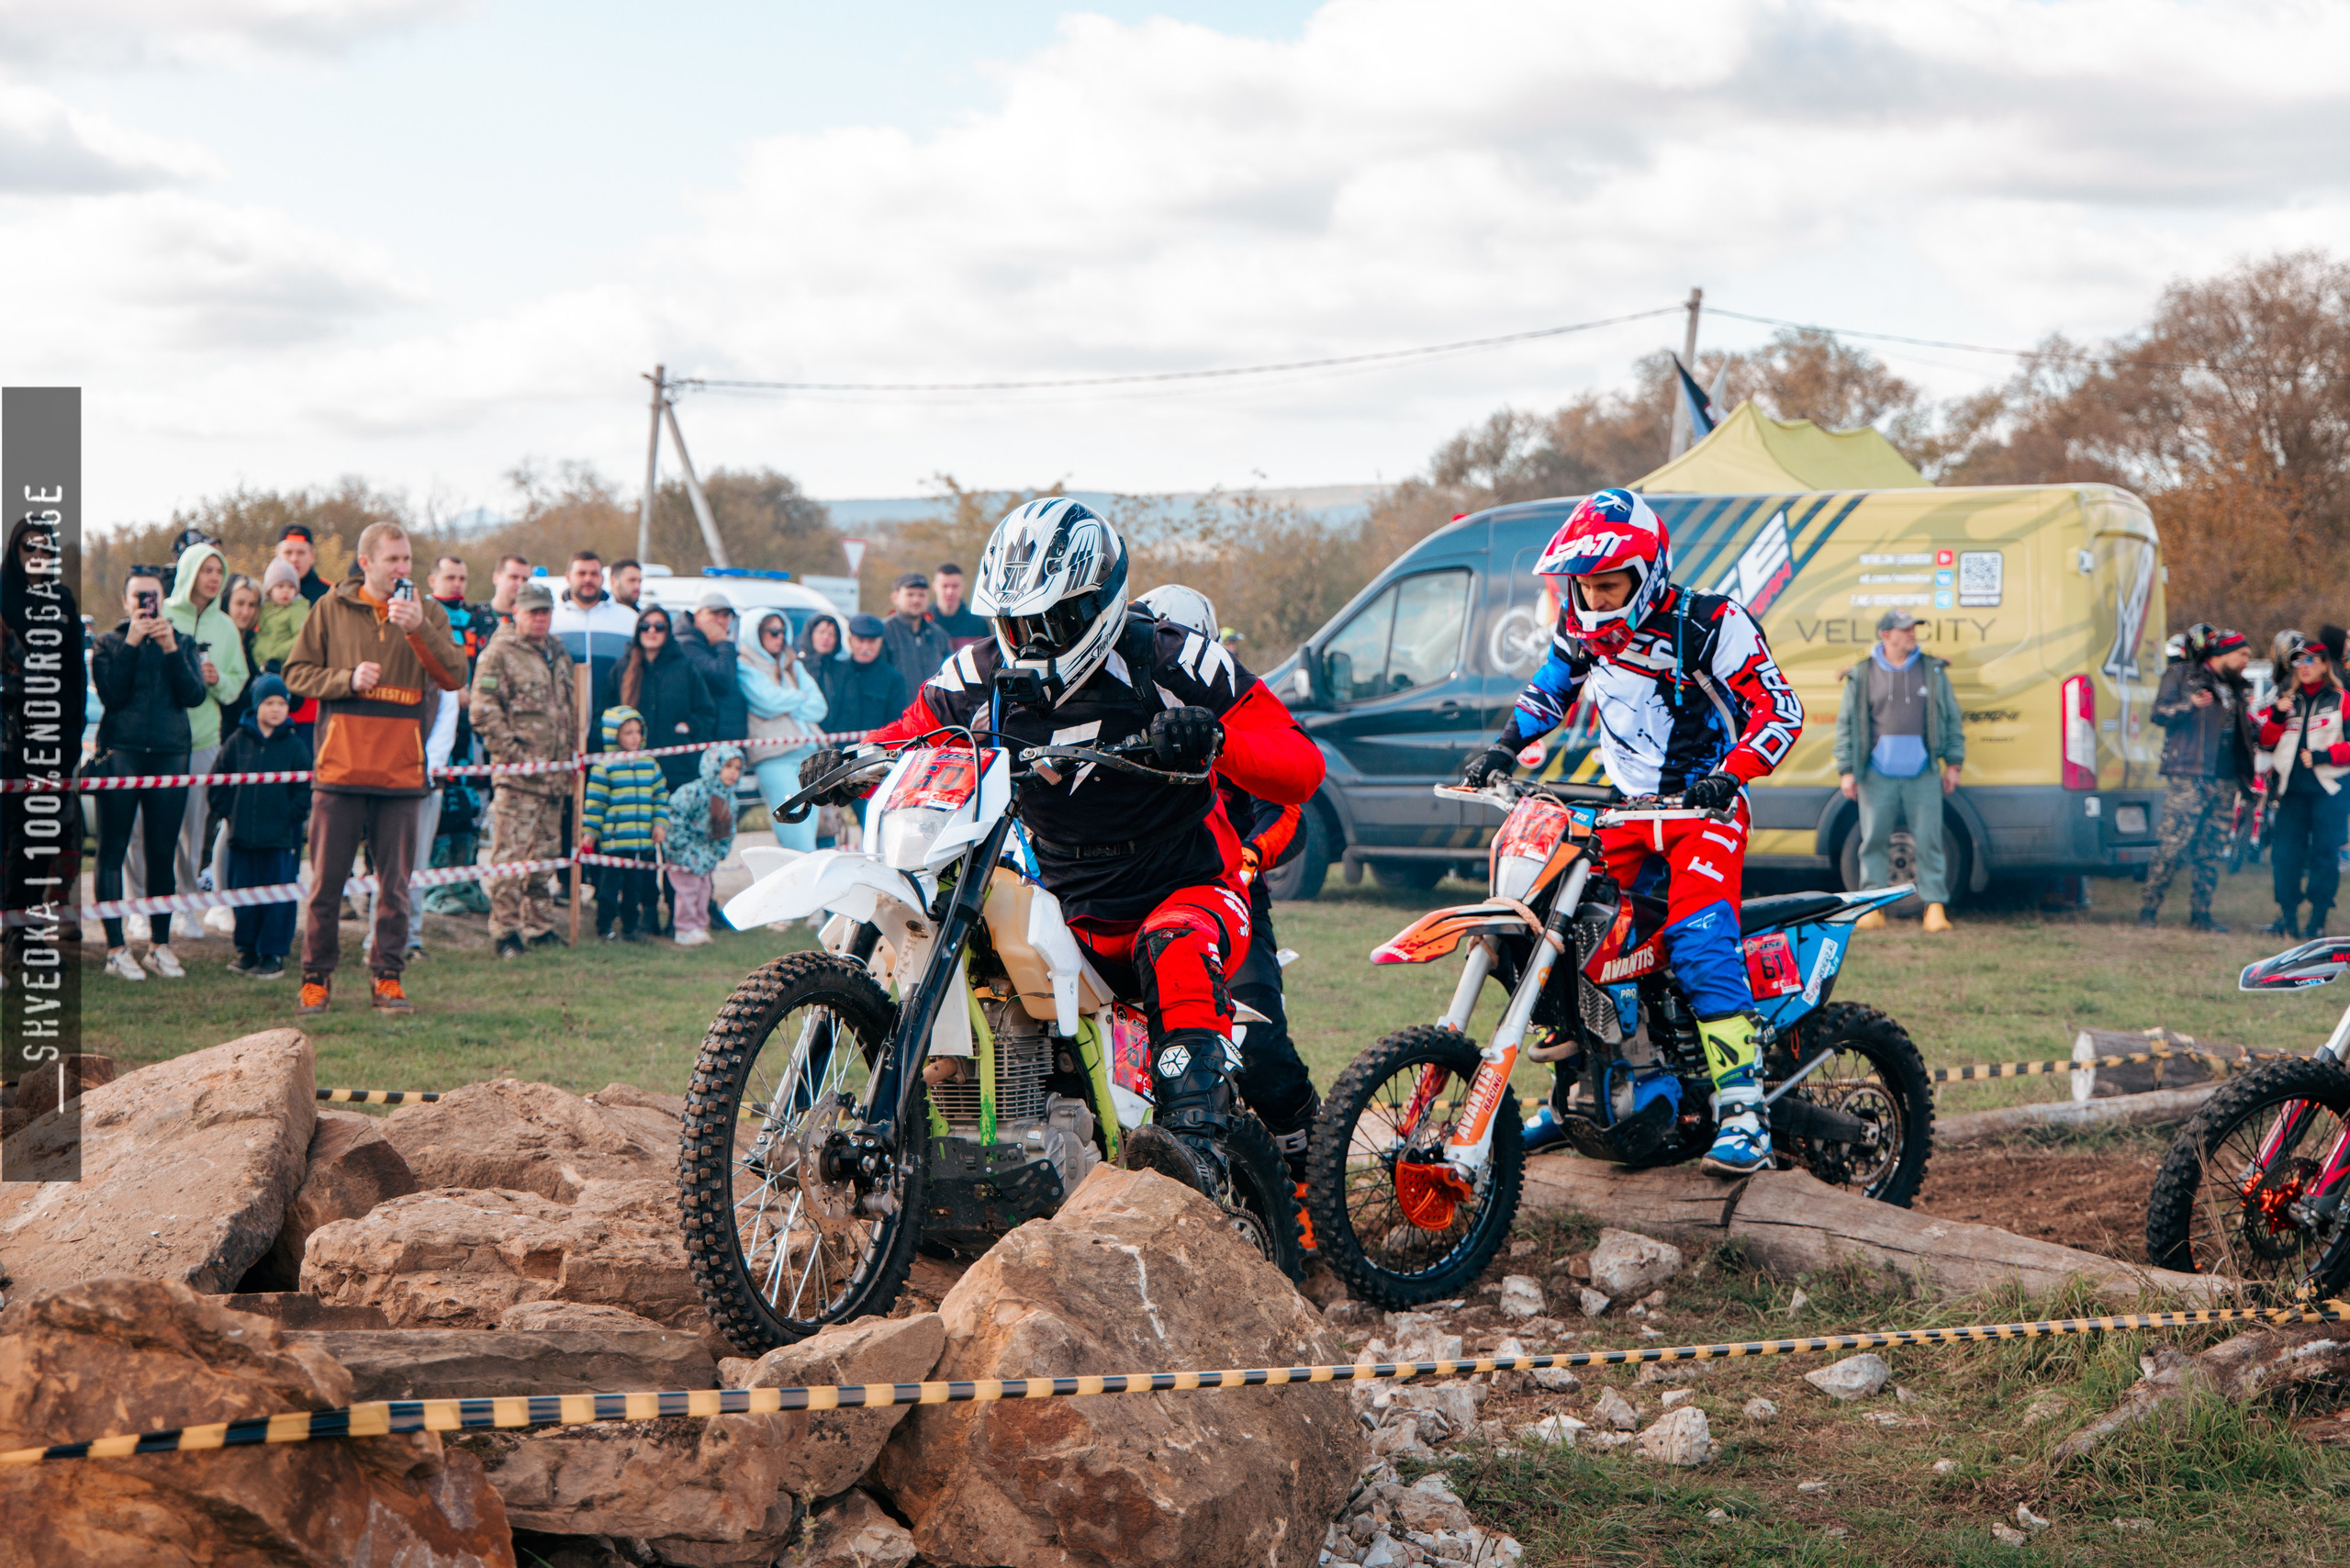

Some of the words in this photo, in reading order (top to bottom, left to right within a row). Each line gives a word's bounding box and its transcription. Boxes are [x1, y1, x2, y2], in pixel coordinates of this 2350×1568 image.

[1796, 618, 1996, 643] VELCITY
[912, 765, 965, 790] 60
[1599, 946, 1654, 981] AVANTIS
[1761, 954, 1785, 980] 61
[1457, 1064, 1494, 1140] AVANTIS
[1483, 1075, 1503, 1113] RACING
